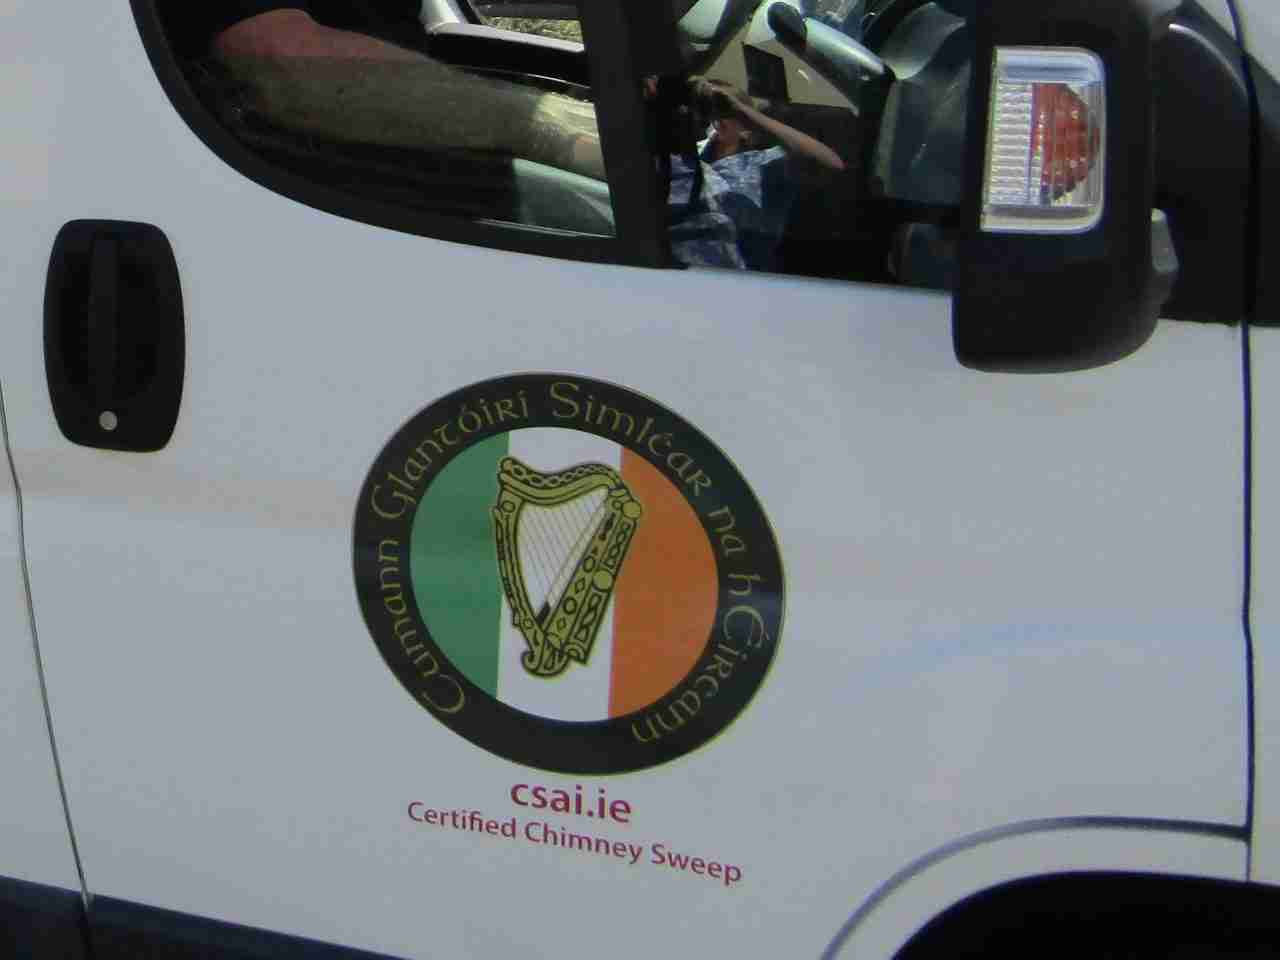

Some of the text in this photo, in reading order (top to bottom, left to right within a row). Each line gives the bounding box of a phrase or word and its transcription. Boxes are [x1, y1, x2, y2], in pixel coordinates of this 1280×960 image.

[377, 539, 466, 714] Cumann
[407, 800, 743, 887] Certified Chimney Sweep
[509, 783, 632, 824] csai.ie
